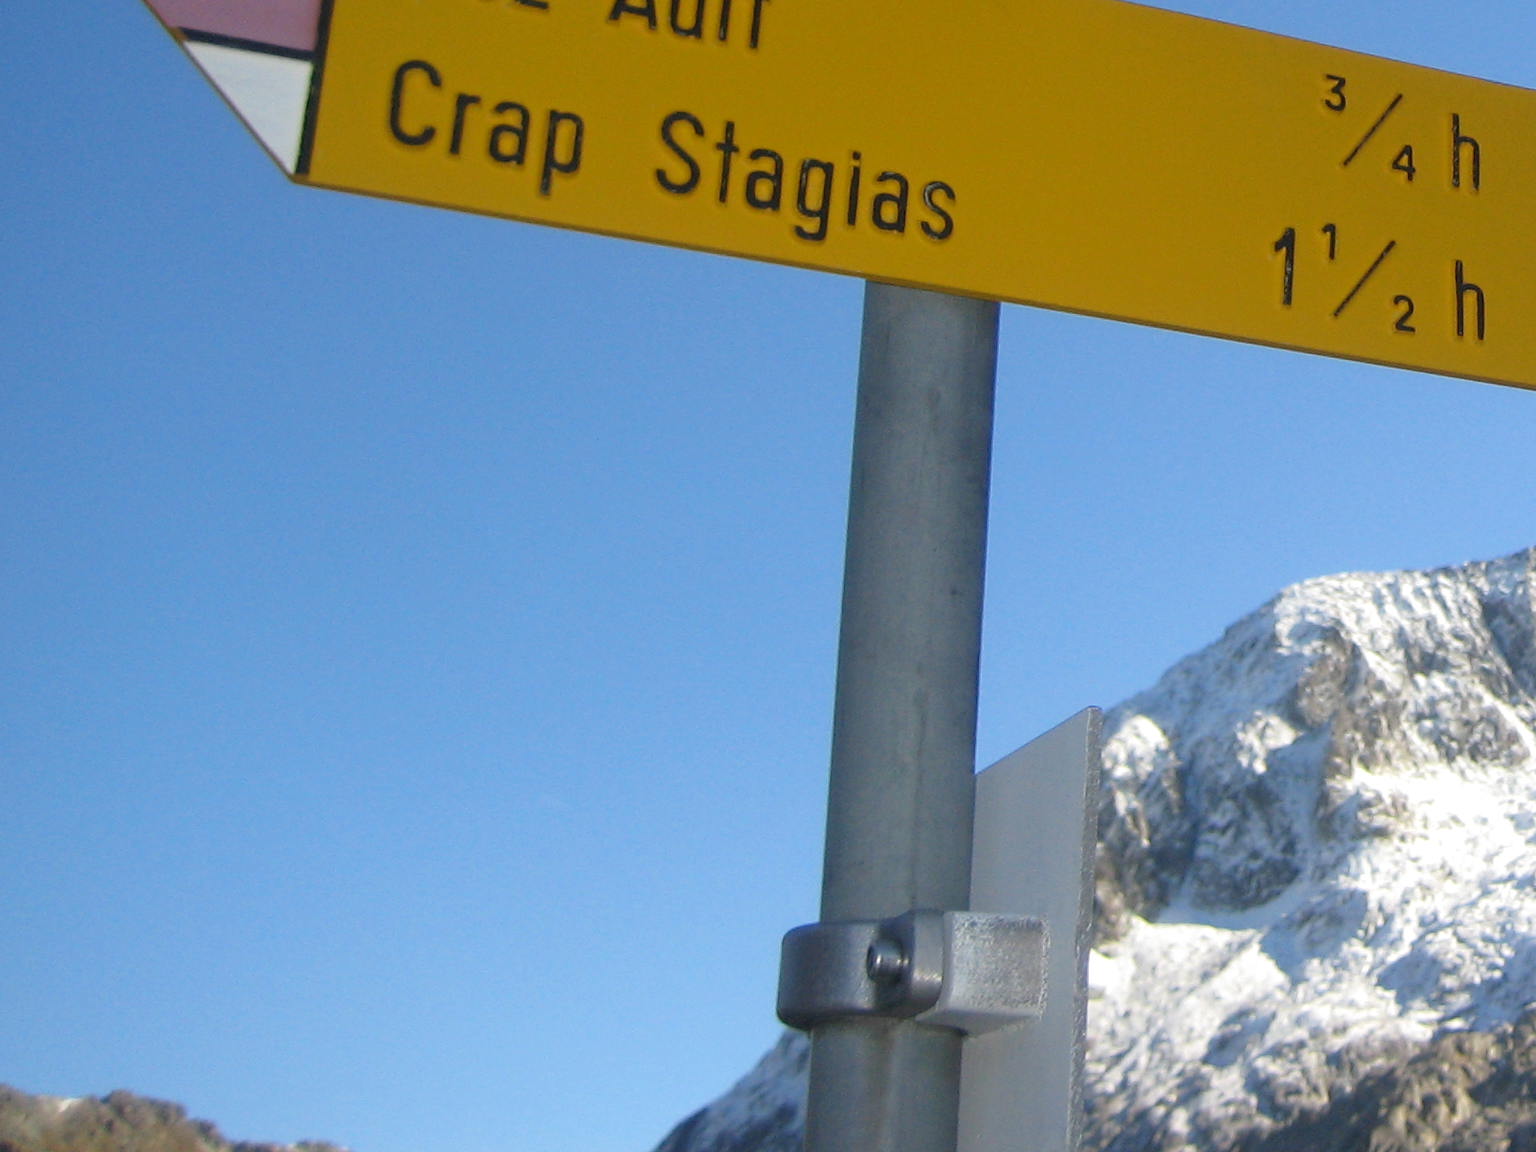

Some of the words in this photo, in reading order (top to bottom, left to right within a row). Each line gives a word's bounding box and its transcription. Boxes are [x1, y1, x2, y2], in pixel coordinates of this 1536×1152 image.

[387, 60, 585, 198] Crap
[654, 110, 957, 242] Stagias
[1451, 112, 1480, 192] h
[1454, 259, 1486, 341] h
